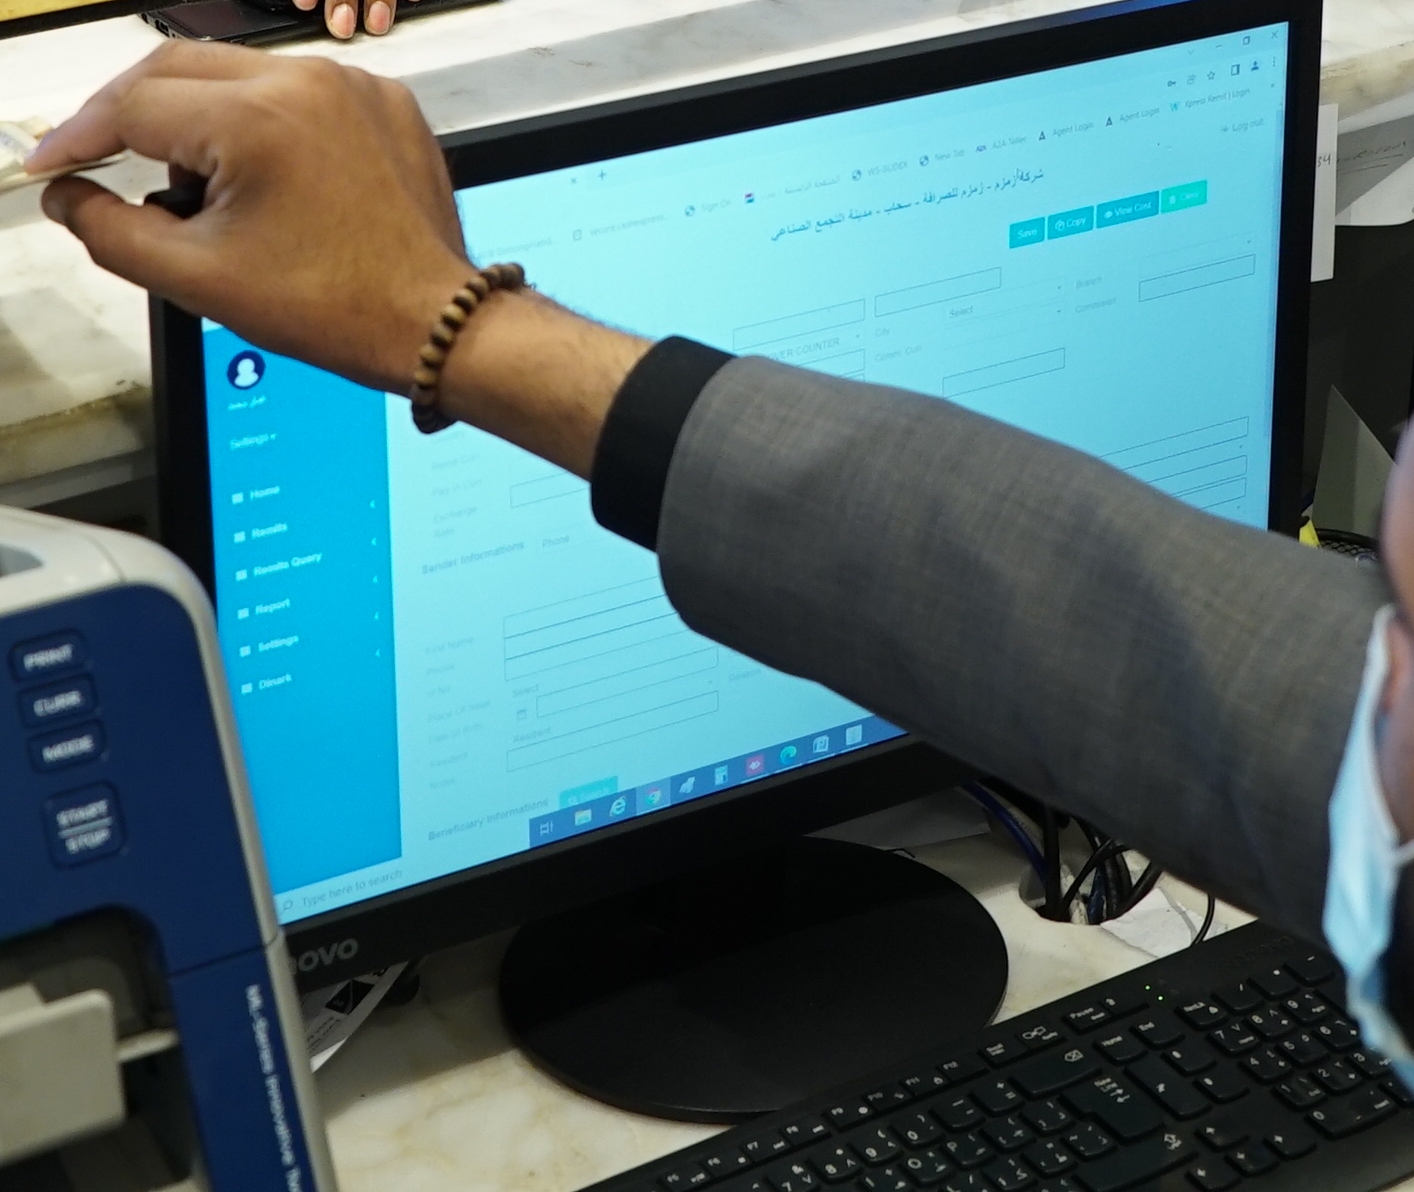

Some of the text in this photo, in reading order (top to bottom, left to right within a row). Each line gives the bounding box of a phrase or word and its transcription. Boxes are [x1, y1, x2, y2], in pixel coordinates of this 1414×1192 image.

[1231, 118, 1264, 134] Log out
[1066, 217, 1087, 231] Copy
[1017, 228, 1038, 240] Save
[949, 306, 974, 319] Select
[796, 337, 840, 356] COUNTER
[230, 435, 269, 450] Settings
[250, 486, 280, 502] Home
[291, 552, 323, 569] Query
[421, 557, 457, 575] Sender
[255, 597, 290, 616] Report
[258, 634, 299, 653] Settings
[512, 682, 540, 698] Select
[428, 816, 484, 842] Beneficiary
[487, 797, 549, 824] Informations
[301, 868, 403, 908] Type here to search
